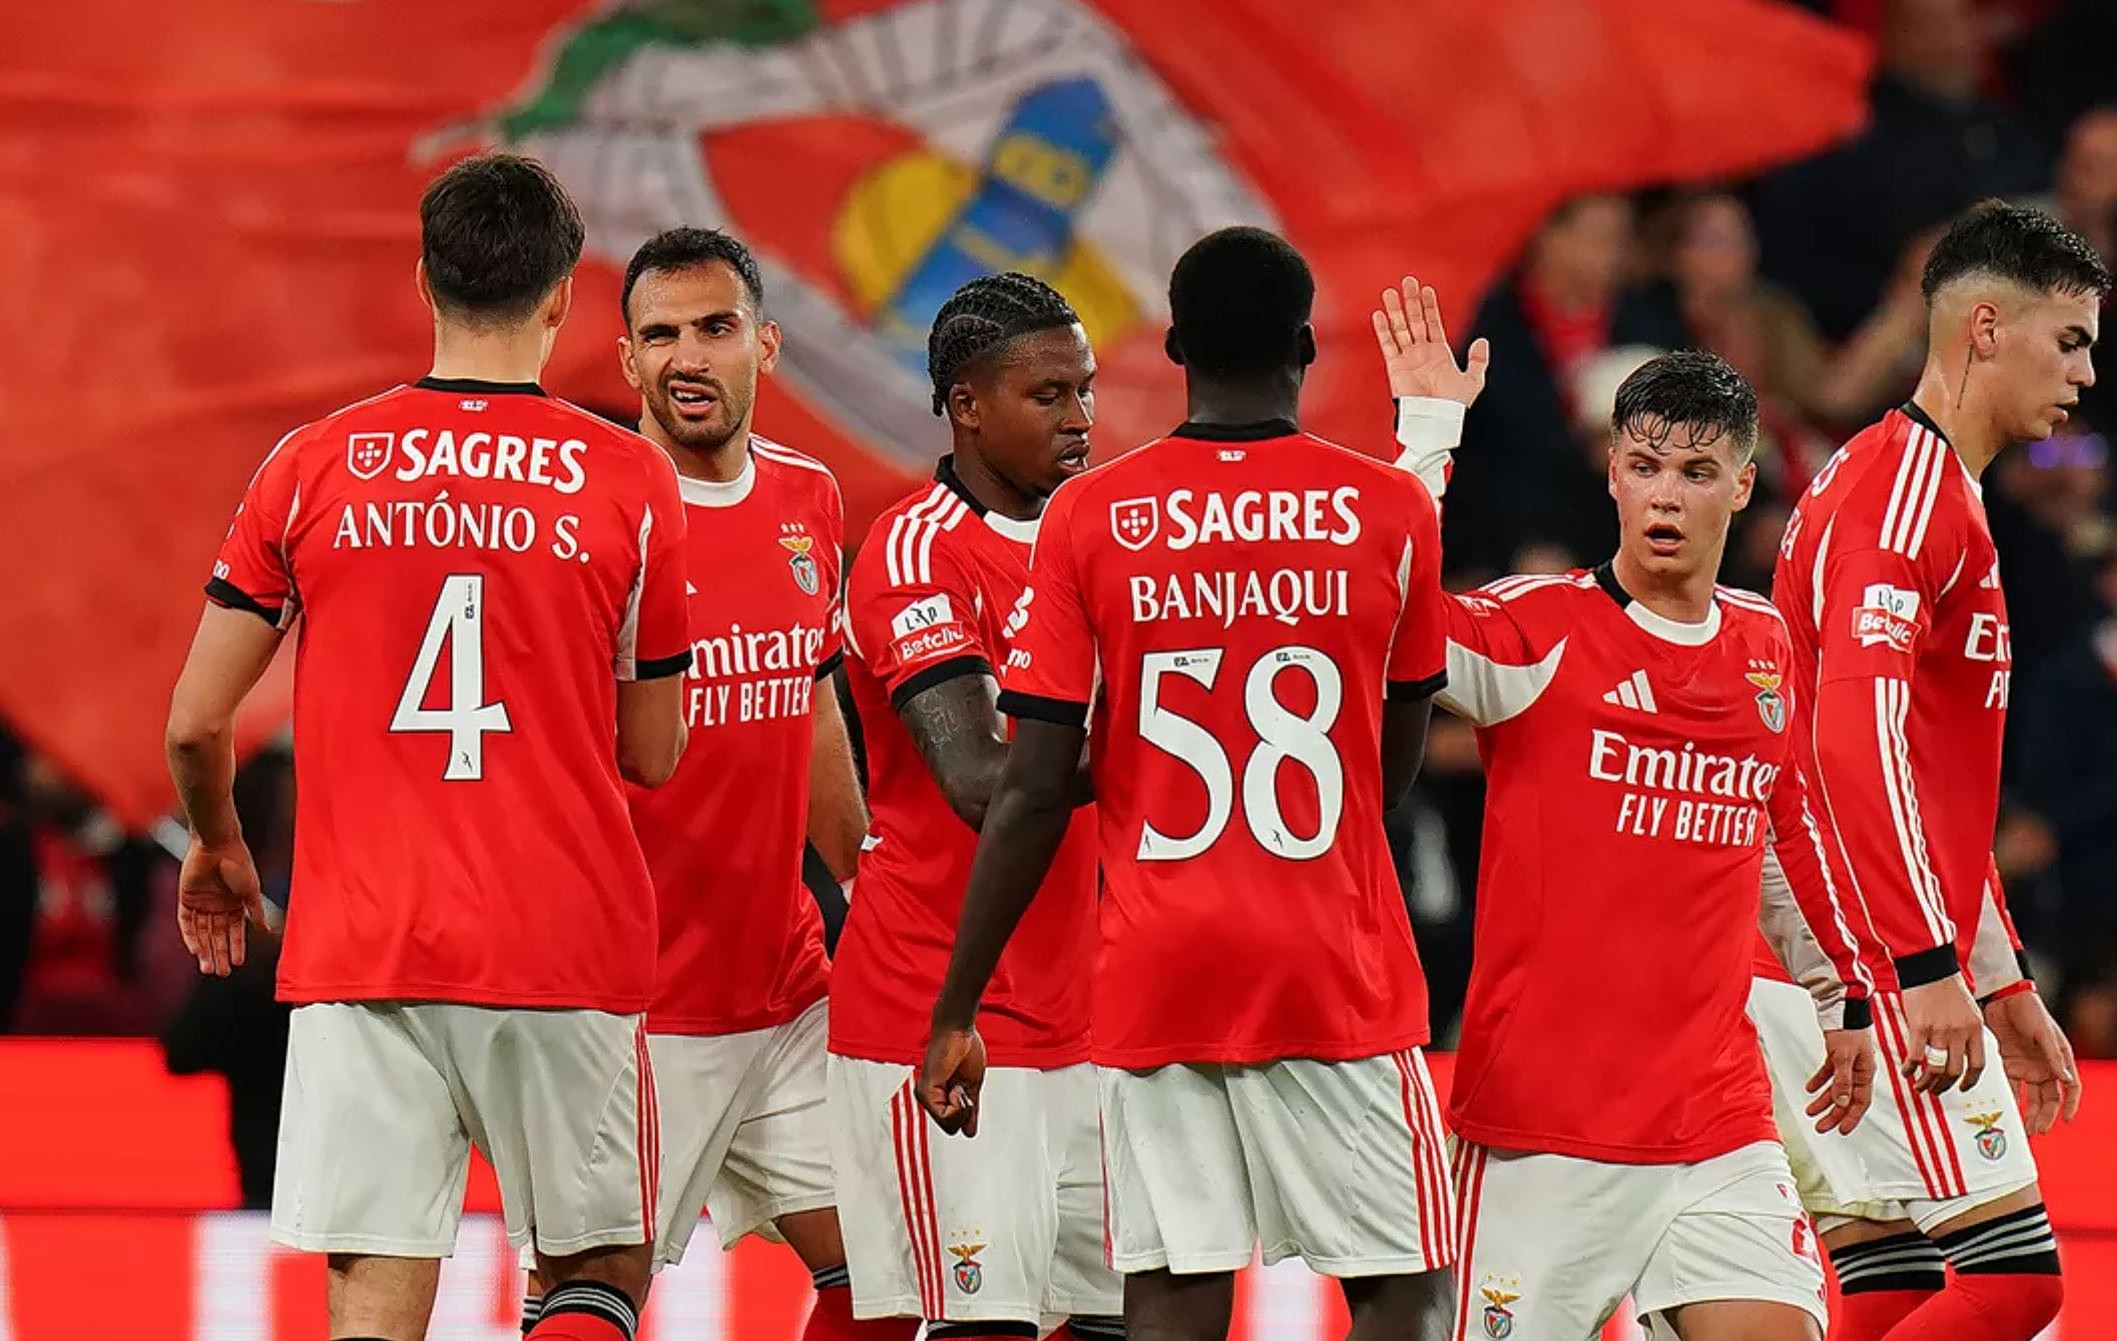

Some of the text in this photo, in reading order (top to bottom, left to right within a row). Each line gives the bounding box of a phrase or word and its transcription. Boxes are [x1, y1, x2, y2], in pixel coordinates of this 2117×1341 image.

[395, 428, 587, 494] SAGRES
[333, 489, 591, 563] ANTÓNIO S.
[1166, 486, 1361, 550] SAGRES
[1129, 569, 1349, 630] BANJAQUI
[388, 573, 512, 782] 4
[688, 622, 826, 680] mirate
[688, 675, 812, 728] FLY BETTER
[1136, 645, 1345, 862] 58
[1616, 793, 1758, 846] FLY BETTER
